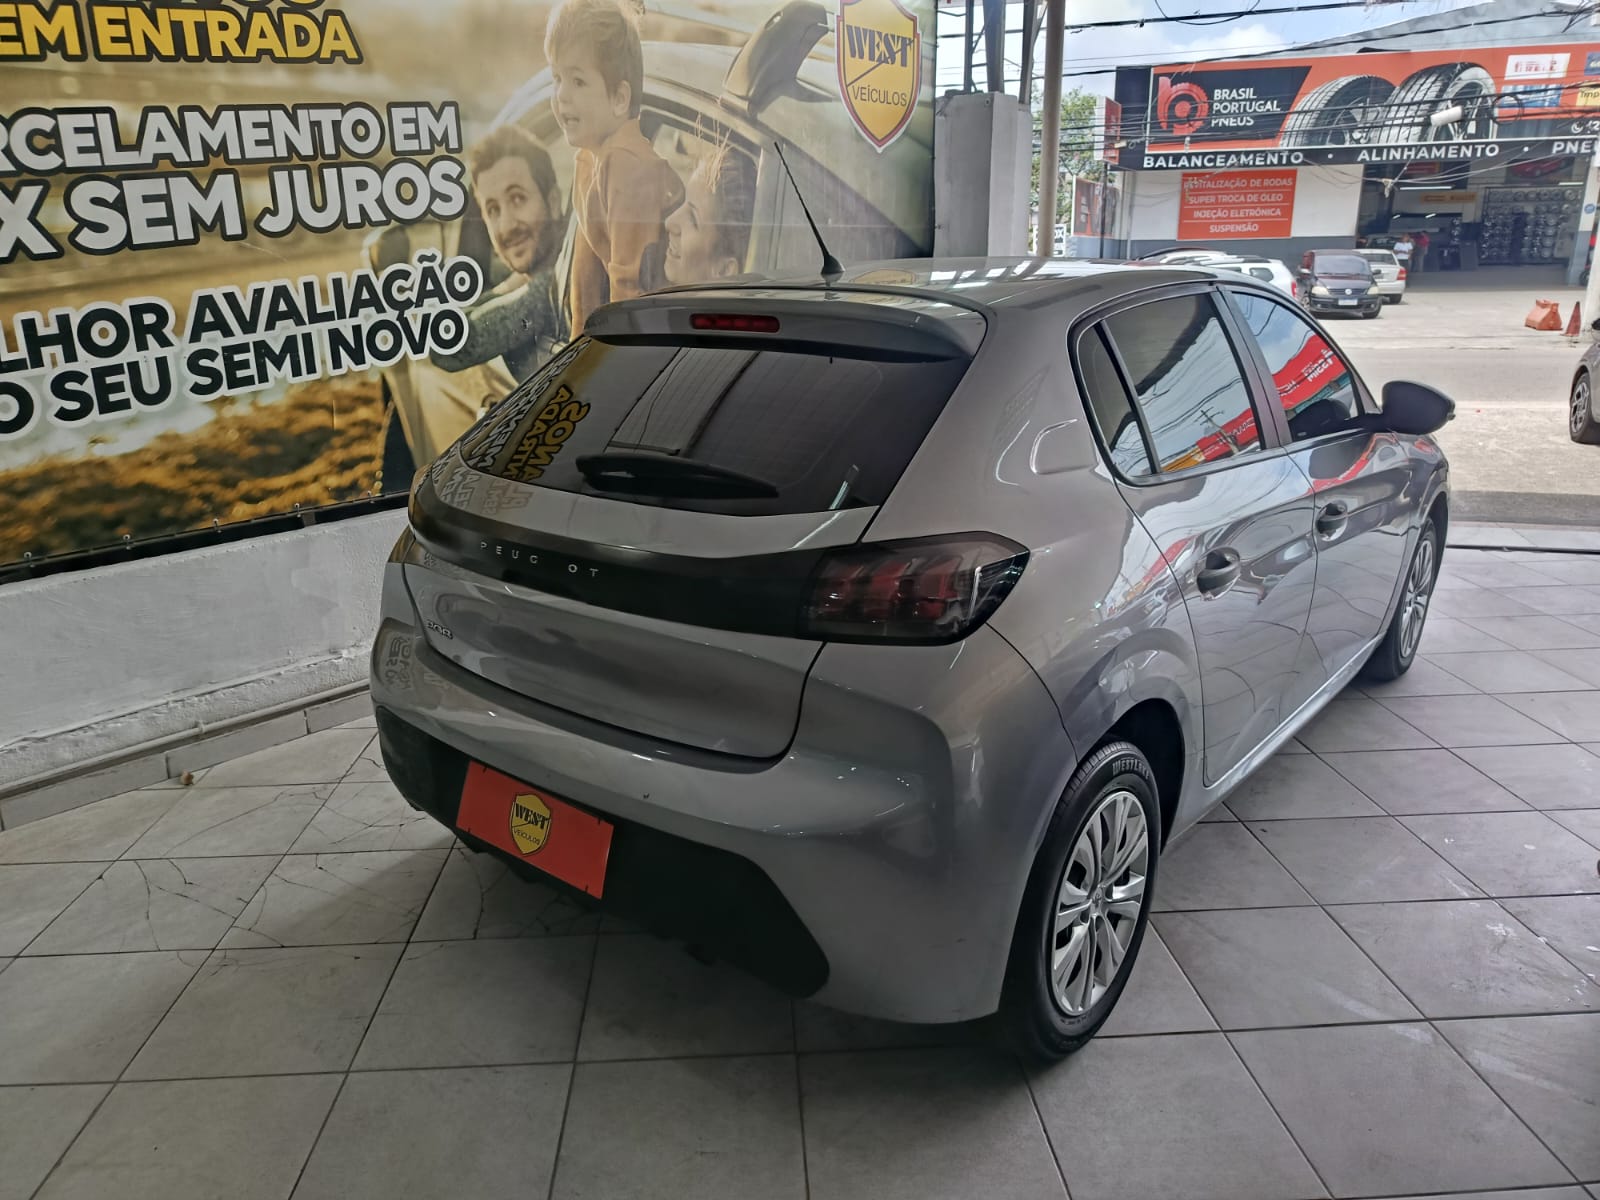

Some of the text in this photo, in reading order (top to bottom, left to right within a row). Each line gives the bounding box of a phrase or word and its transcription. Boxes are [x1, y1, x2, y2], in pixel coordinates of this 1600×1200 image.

[93, 7, 360, 60] ENTRADA
[846, 24, 913, 68] WEST
[852, 85, 907, 107] VEÍCULOS
[1213, 87, 1257, 101] BRASIL
[1212, 100, 1281, 115] PORTUGAL
[0, 105, 459, 171] CELAMENTO EM
[1143, 151, 1304, 169] BALANCEAMENTO
[1357, 144, 1499, 162] ALINHAMENTO
[1250, 179, 1260, 187] DE
[1263, 178, 1292, 187] RODAS
[69, 173, 243, 250] SEM
[258, 160, 466, 234] JUROS
[1189, 195, 1216, 204] SUPER
[1218, 194, 1245, 203] TROCA
[1247, 194, 1258, 202] DE
[1194, 208, 1228, 219] INJEÇÃO
[1209, 222, 1259, 232] SUSPENSÃO
[189, 253, 480, 344] AVALIAÇÃO
[51, 355, 173, 422] SEU
[187, 331, 317, 396] SEMI
[328, 308, 466, 370] NOVO
[479, 540, 600, 578] PEUGOT
[515, 803, 550, 830] WEST
